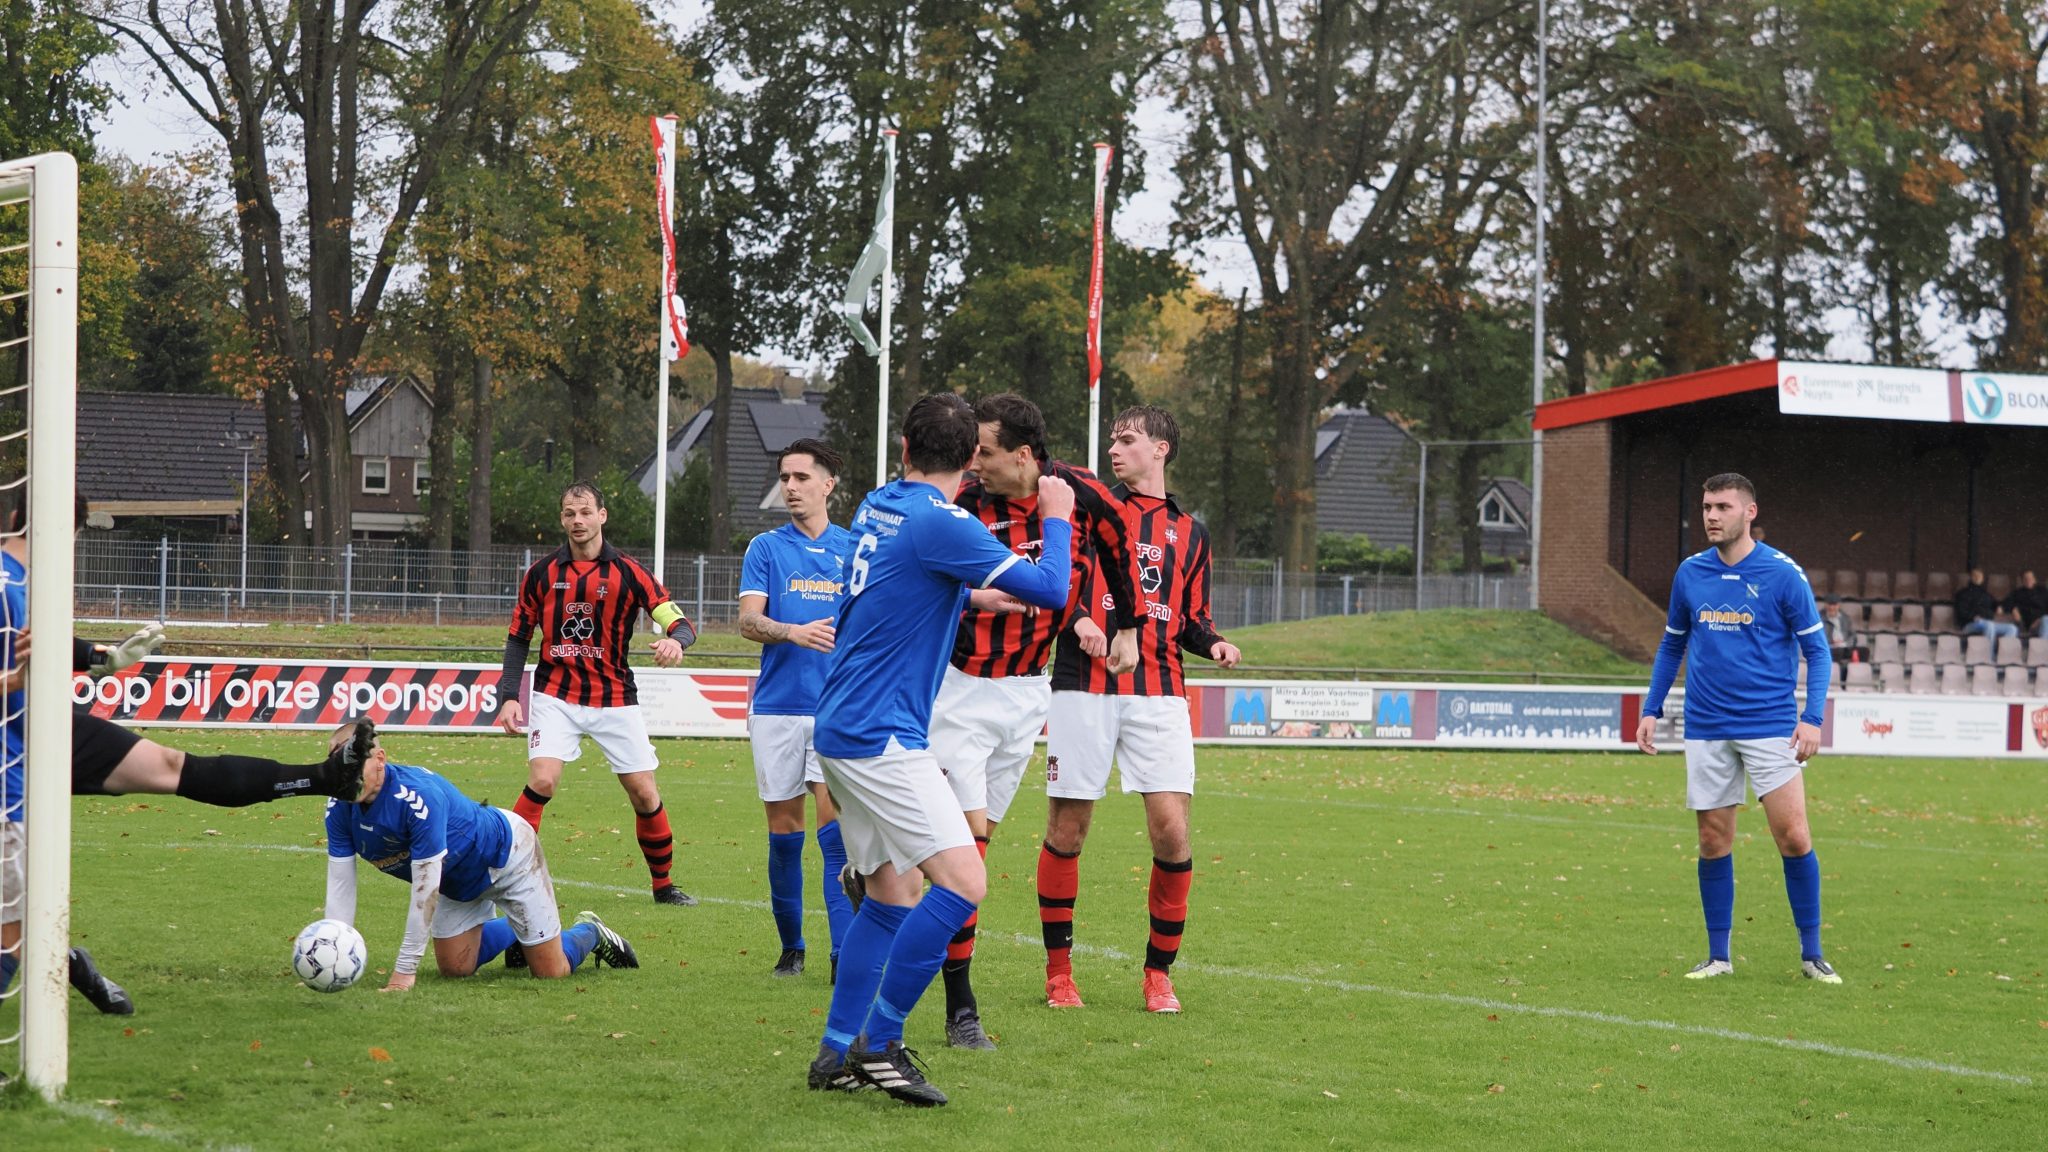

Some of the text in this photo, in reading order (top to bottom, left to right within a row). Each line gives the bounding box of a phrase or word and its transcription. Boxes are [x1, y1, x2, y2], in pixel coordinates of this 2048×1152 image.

[850, 533, 878, 596] 6
[566, 602, 593, 615] GFC
[1698, 611, 1753, 625] JUMBO
[550, 644, 605, 659] SUPPORT
[72, 670, 498, 718] oop bij onze sponsors
[1229, 722, 1266, 736] mitra
[1375, 724, 1412, 738] mitra
